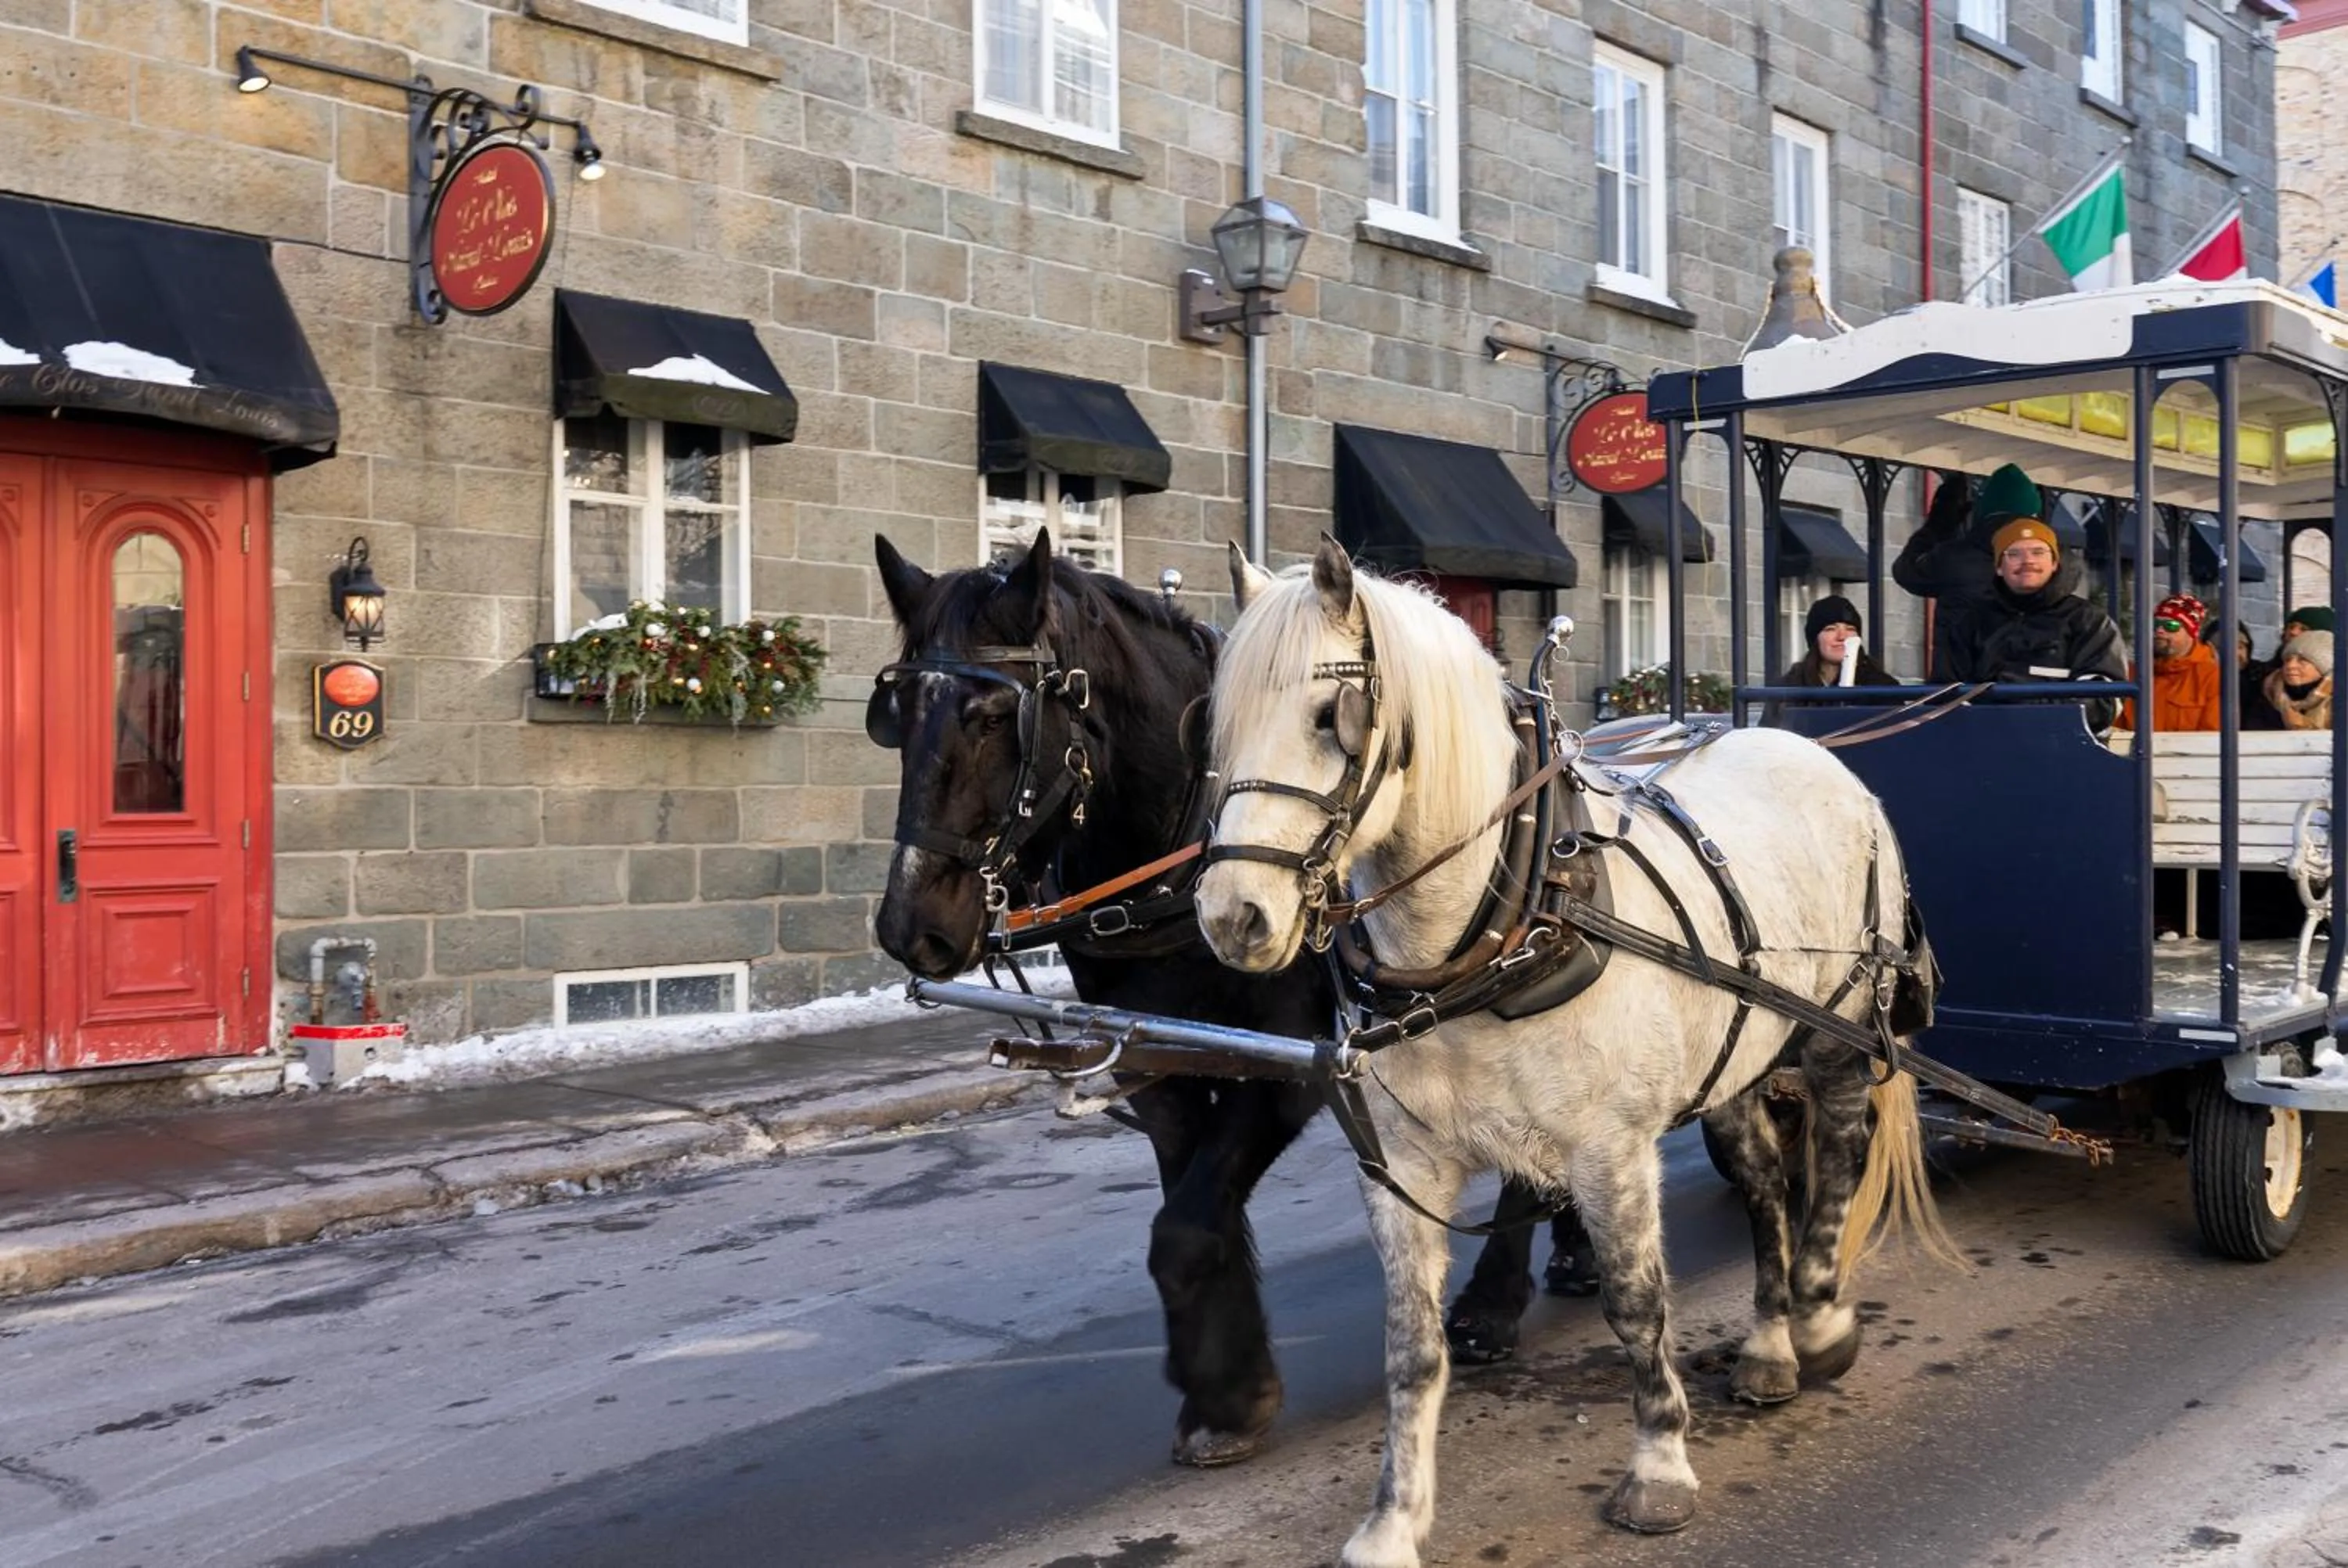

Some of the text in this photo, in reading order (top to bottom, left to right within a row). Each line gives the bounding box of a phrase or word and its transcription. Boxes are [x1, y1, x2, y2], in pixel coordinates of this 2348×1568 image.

[31, 363, 99, 396] Clos
[213, 389, 279, 428] Louis
[330, 710, 374, 738] 69
[1073, 802, 1086, 825] 4
